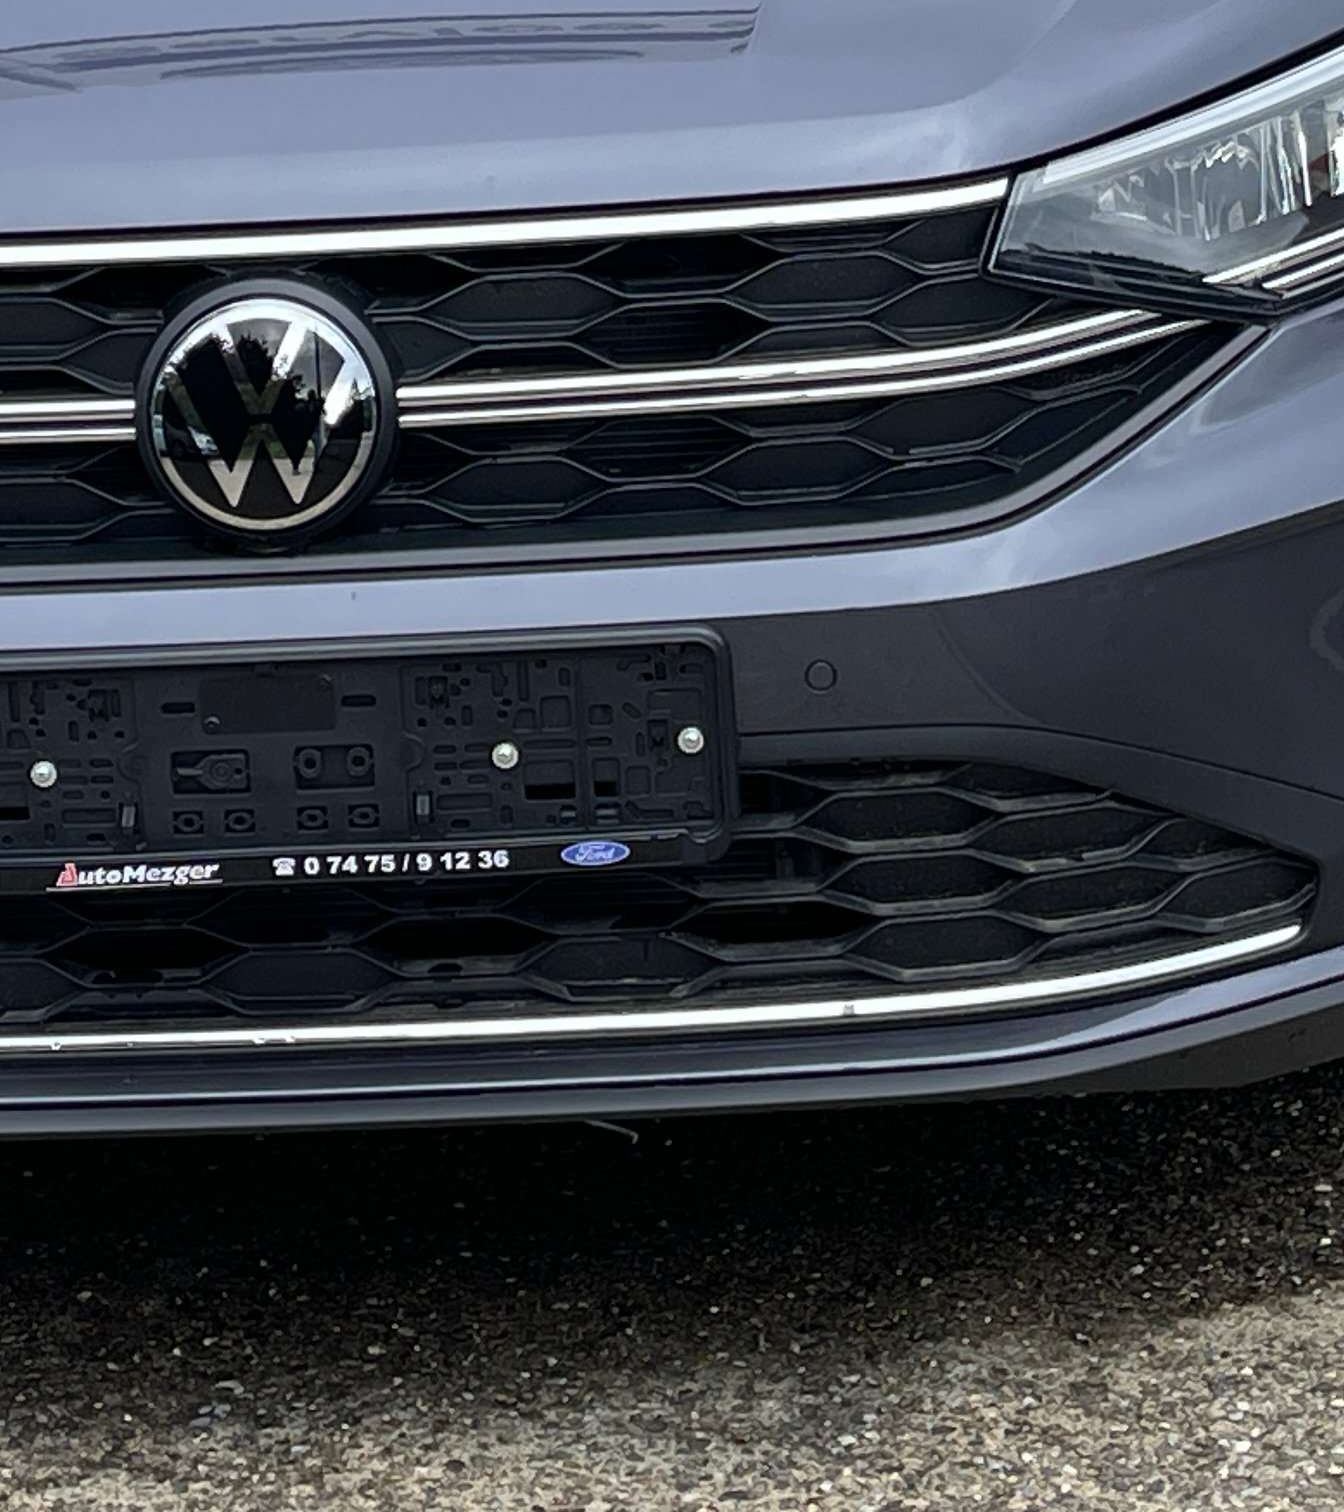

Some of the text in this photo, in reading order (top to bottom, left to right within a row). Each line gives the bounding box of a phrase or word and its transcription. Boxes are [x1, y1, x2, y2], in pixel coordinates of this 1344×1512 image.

[303, 855, 320, 875] 0
[326, 853, 358, 874] 74
[364, 853, 396, 873] 75
[416, 851, 433, 871] 9
[440, 850, 471, 870] 12
[478, 849, 510, 869] 36
[573, 843, 617, 864] Ford
[56, 863, 220, 885] AutoMezger
